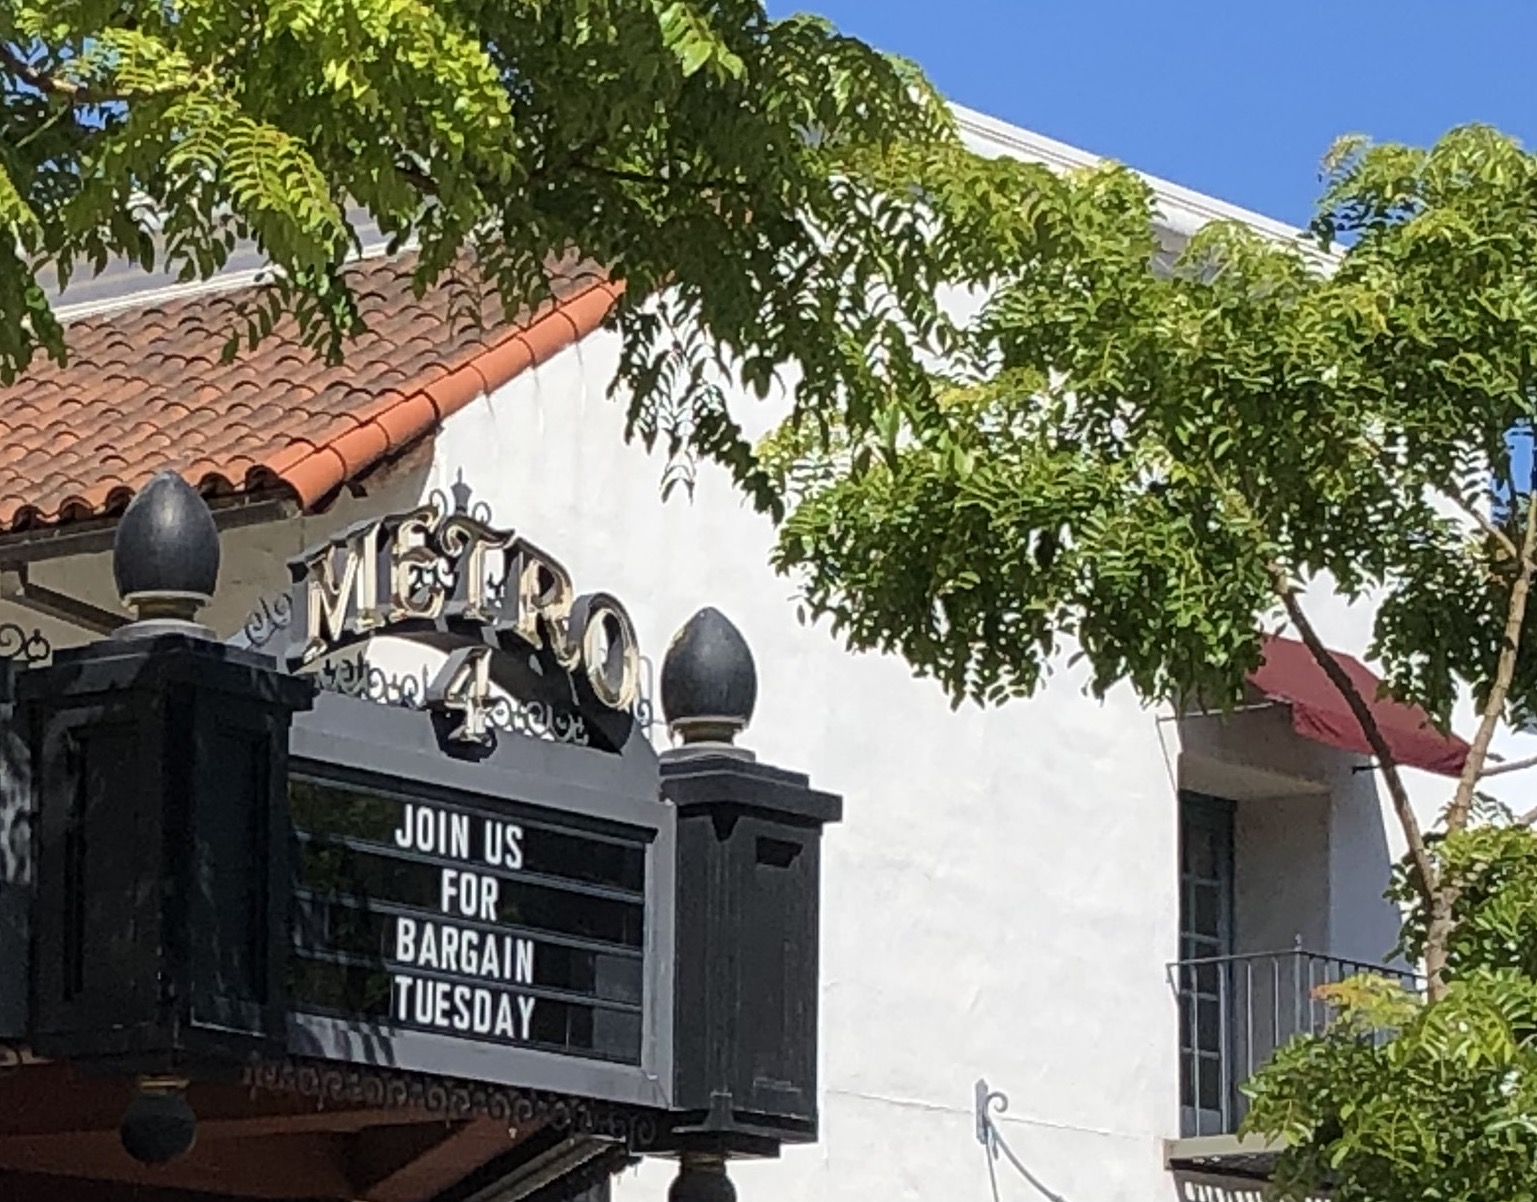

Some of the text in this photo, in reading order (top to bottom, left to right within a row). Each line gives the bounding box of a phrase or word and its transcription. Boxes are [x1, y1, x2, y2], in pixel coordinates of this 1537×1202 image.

[288, 508, 641, 712] METRO
[436, 646, 494, 747] 4
[395, 804, 522, 869] JOIN US
[442, 868, 498, 921] FOR
[396, 917, 534, 984] BARGAIN
[394, 975, 535, 1040] TUESDAY
